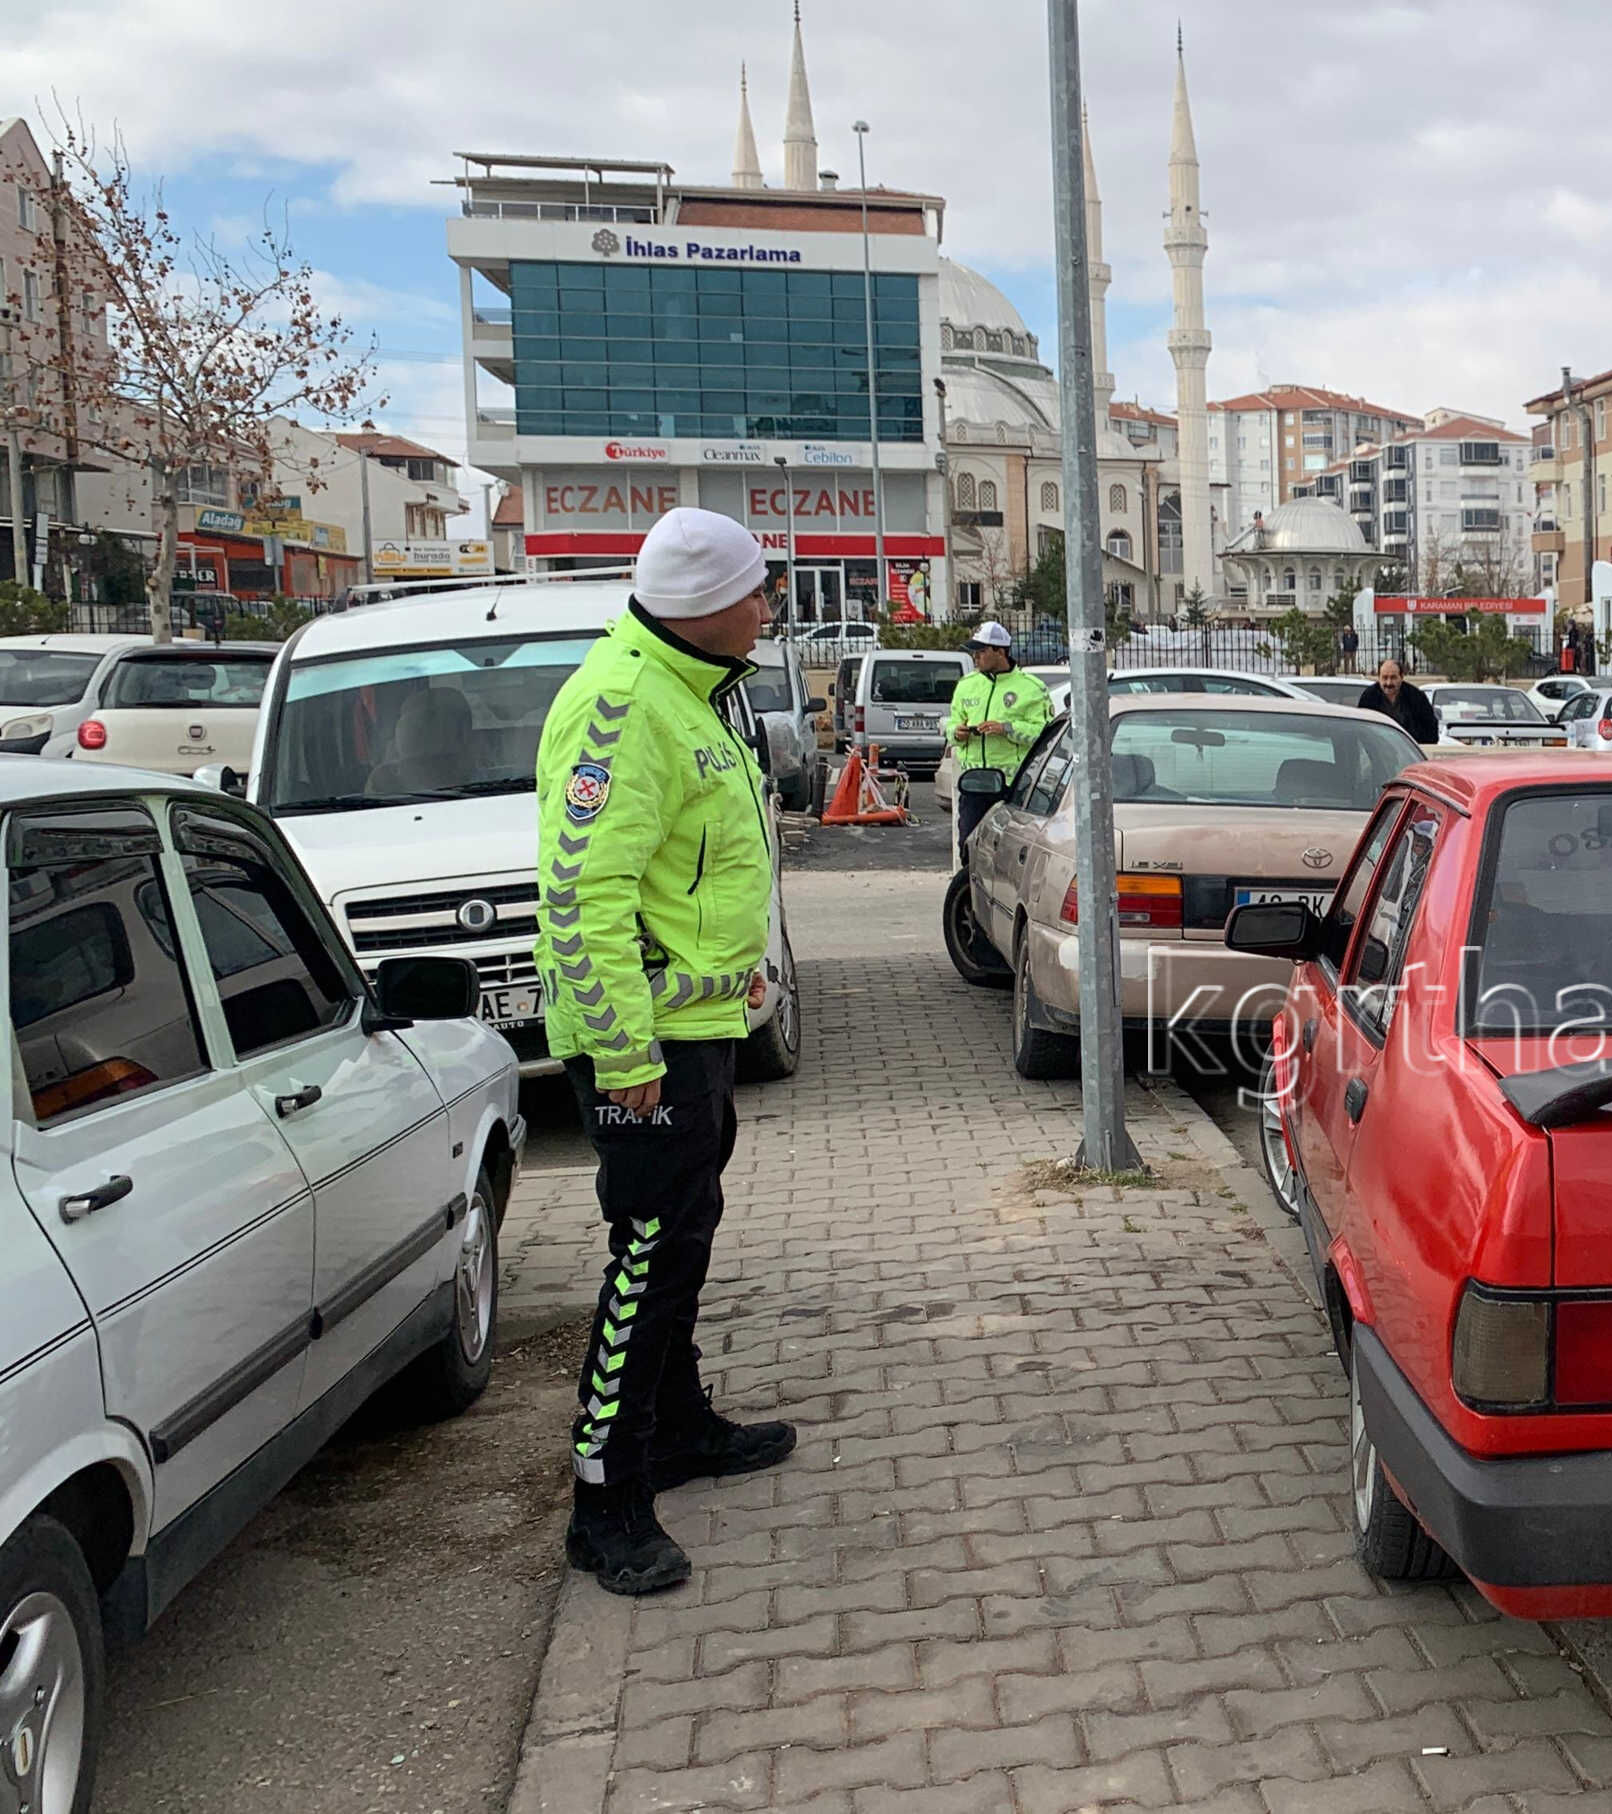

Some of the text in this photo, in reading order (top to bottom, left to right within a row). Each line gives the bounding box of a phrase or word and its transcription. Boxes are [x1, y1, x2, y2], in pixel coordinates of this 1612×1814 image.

[625, 235, 802, 263] İhlas Pazarlama
[605, 441, 666, 460] Türkiye
[703, 448, 761, 461] Cleanmax
[546, 485, 680, 514] ECZANE
[750, 488, 877, 516] ECZANE
[1420, 601, 1463, 610] KARAMAN
[482, 991, 513, 1020] AE
